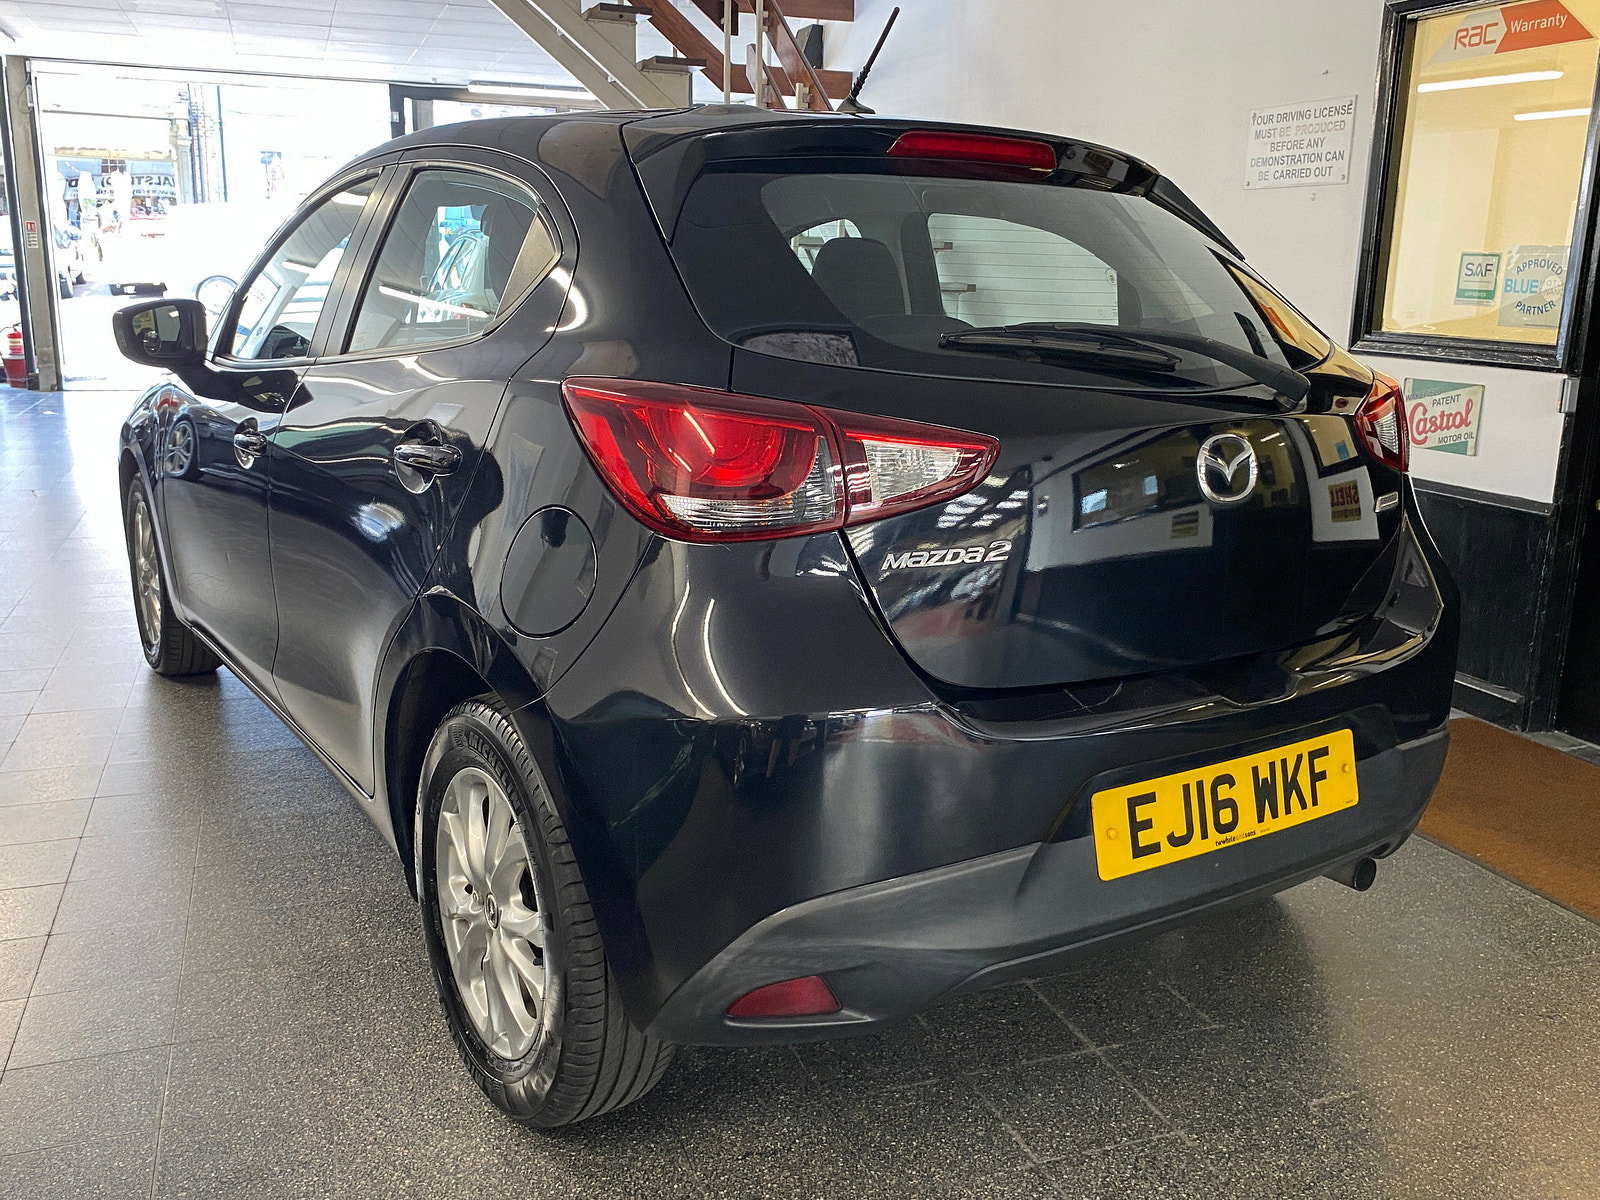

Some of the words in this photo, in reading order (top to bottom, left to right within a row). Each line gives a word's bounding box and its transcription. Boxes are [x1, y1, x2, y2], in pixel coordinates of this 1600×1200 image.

[1510, 13, 1568, 33] Warranty
[1252, 114, 1274, 126] YOUR
[1276, 109, 1311, 123] DRIVING
[1313, 103, 1353, 118] LICENSE
[1255, 127, 1278, 140] MUST
[1279, 126, 1291, 137] BE
[1295, 120, 1346, 136] PRODUCED
[1270, 139, 1305, 152] BEFORE
[1306, 137, 1326, 149] ANY
[1250, 152, 1323, 168] DEMONSTRATION
[1325, 150, 1345, 162] CAN
[1258, 170, 1269, 181] BE
[1273, 167, 1311, 180] CARRIED
[1314, 166, 1333, 177] OUT
[1465, 262, 1494, 277] SAF
[1516, 259, 1563, 275] APPROVED
[1504, 278, 1539, 294] BLUE
[1515, 300, 1556, 316] PARTNER
[1432, 394, 1462, 407] PATENT
[1409, 398, 1473, 445] Castrol
[1438, 433, 1462, 444] MOTOR
[1463, 431, 1475, 440] OIL
[467, 731, 521, 810] MICHELIN
[1126, 773, 1240, 860] EJ16
[1251, 745, 1330, 824] WKF
